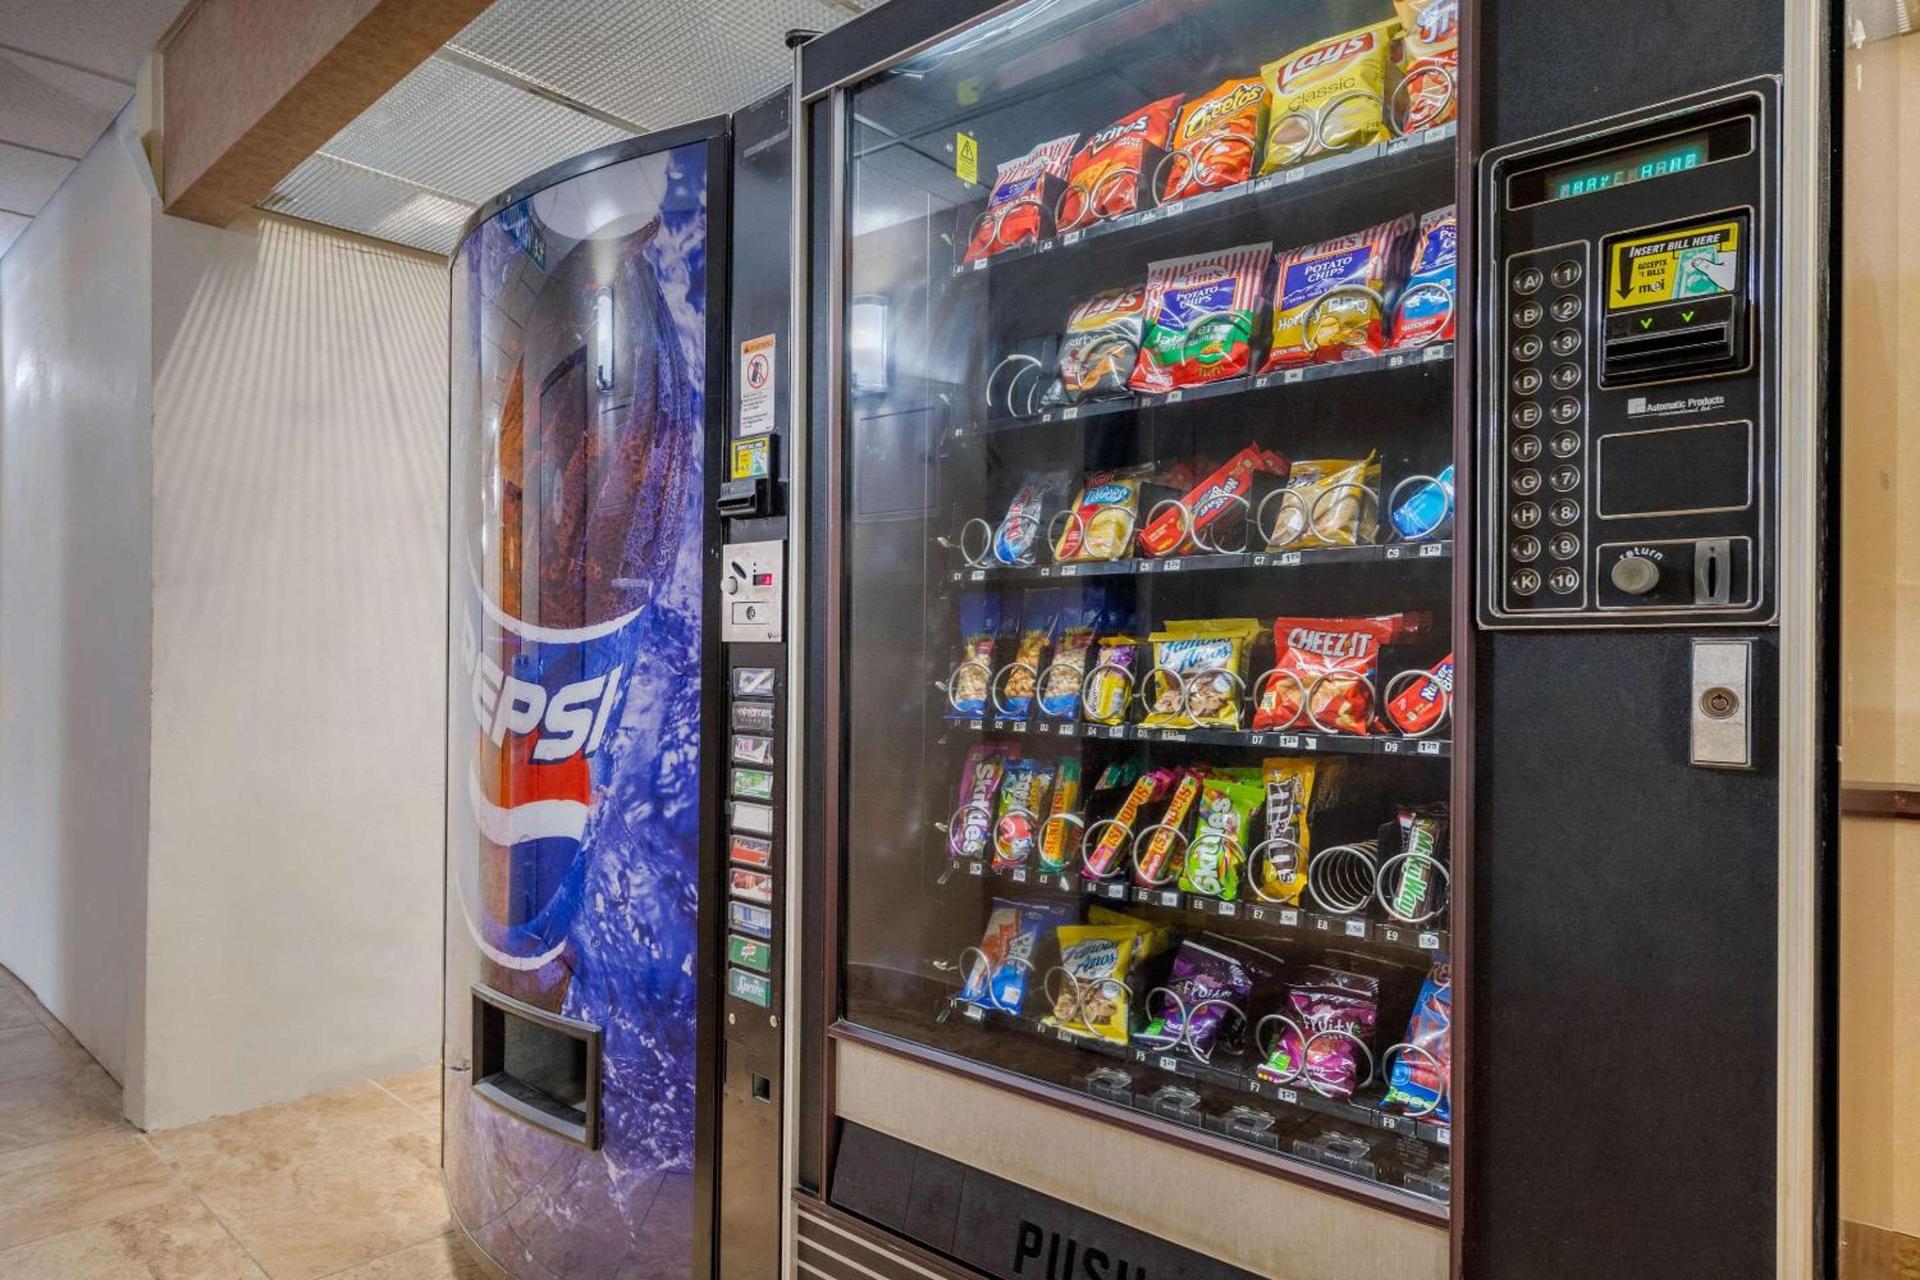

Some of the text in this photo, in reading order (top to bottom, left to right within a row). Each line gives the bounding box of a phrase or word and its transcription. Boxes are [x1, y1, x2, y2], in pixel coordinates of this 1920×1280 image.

[1184, 84, 1264, 138] Cheetos
[1629, 233, 1721, 258] INSERT BILL HERE
[1304, 257, 1353, 276] POTATO
[1638, 258, 1668, 271] ACCEPTS
[1308, 266, 1345, 283] CHIPS
[1564, 269, 1571, 281] 1
[1647, 267, 1666, 278] BILLS
[1524, 275, 1535, 289] A
[1176, 286, 1219, 301] POTATO
[1180, 295, 1213, 309] CHIPS
[1563, 302, 1573, 314] 2
[1524, 309, 1536, 322] B
[1524, 342, 1536, 355] C
[1563, 336, 1572, 349] 3
[1390, 356, 1403, 366] B9
[1523, 375, 1536, 389] D
[1562, 370, 1572, 382] 4
[1256, 379, 1267, 388] B7
[1562, 404, 1572, 418] 5
[1647, 396, 1724, 413] Automatic Products
[1523, 409, 1534, 422] E
[1523, 442, 1534, 456] F
[1561, 438, 1572, 451] 6
[1522, 475, 1536, 489] G
[1561, 472, 1572, 485] 7
[1522, 509, 1535, 522] H
[1561, 506, 1571, 520] 8
[1523, 542, 1533, 556] J
[1560, 540, 1571, 553] 9
[1387, 548, 1399, 559] C9
[1620, 547, 1664, 561] return
[1140, 562, 1150, 571] C5
[1254, 556, 1265, 566] C7
[1521, 576, 1534, 588] K
[1556, 574, 1575, 587] 10
[1137, 729, 1148, 738] D5
[1251, 735, 1263, 744] D7
[1385, 742, 1398, 752] D9
[1253, 909, 1264, 919] E7
[1317, 920, 1329, 930] E8
[1386, 930, 1398, 941] E9
[1250, 1081, 1261, 1092] F7
[1383, 1117, 1395, 1128] F9
